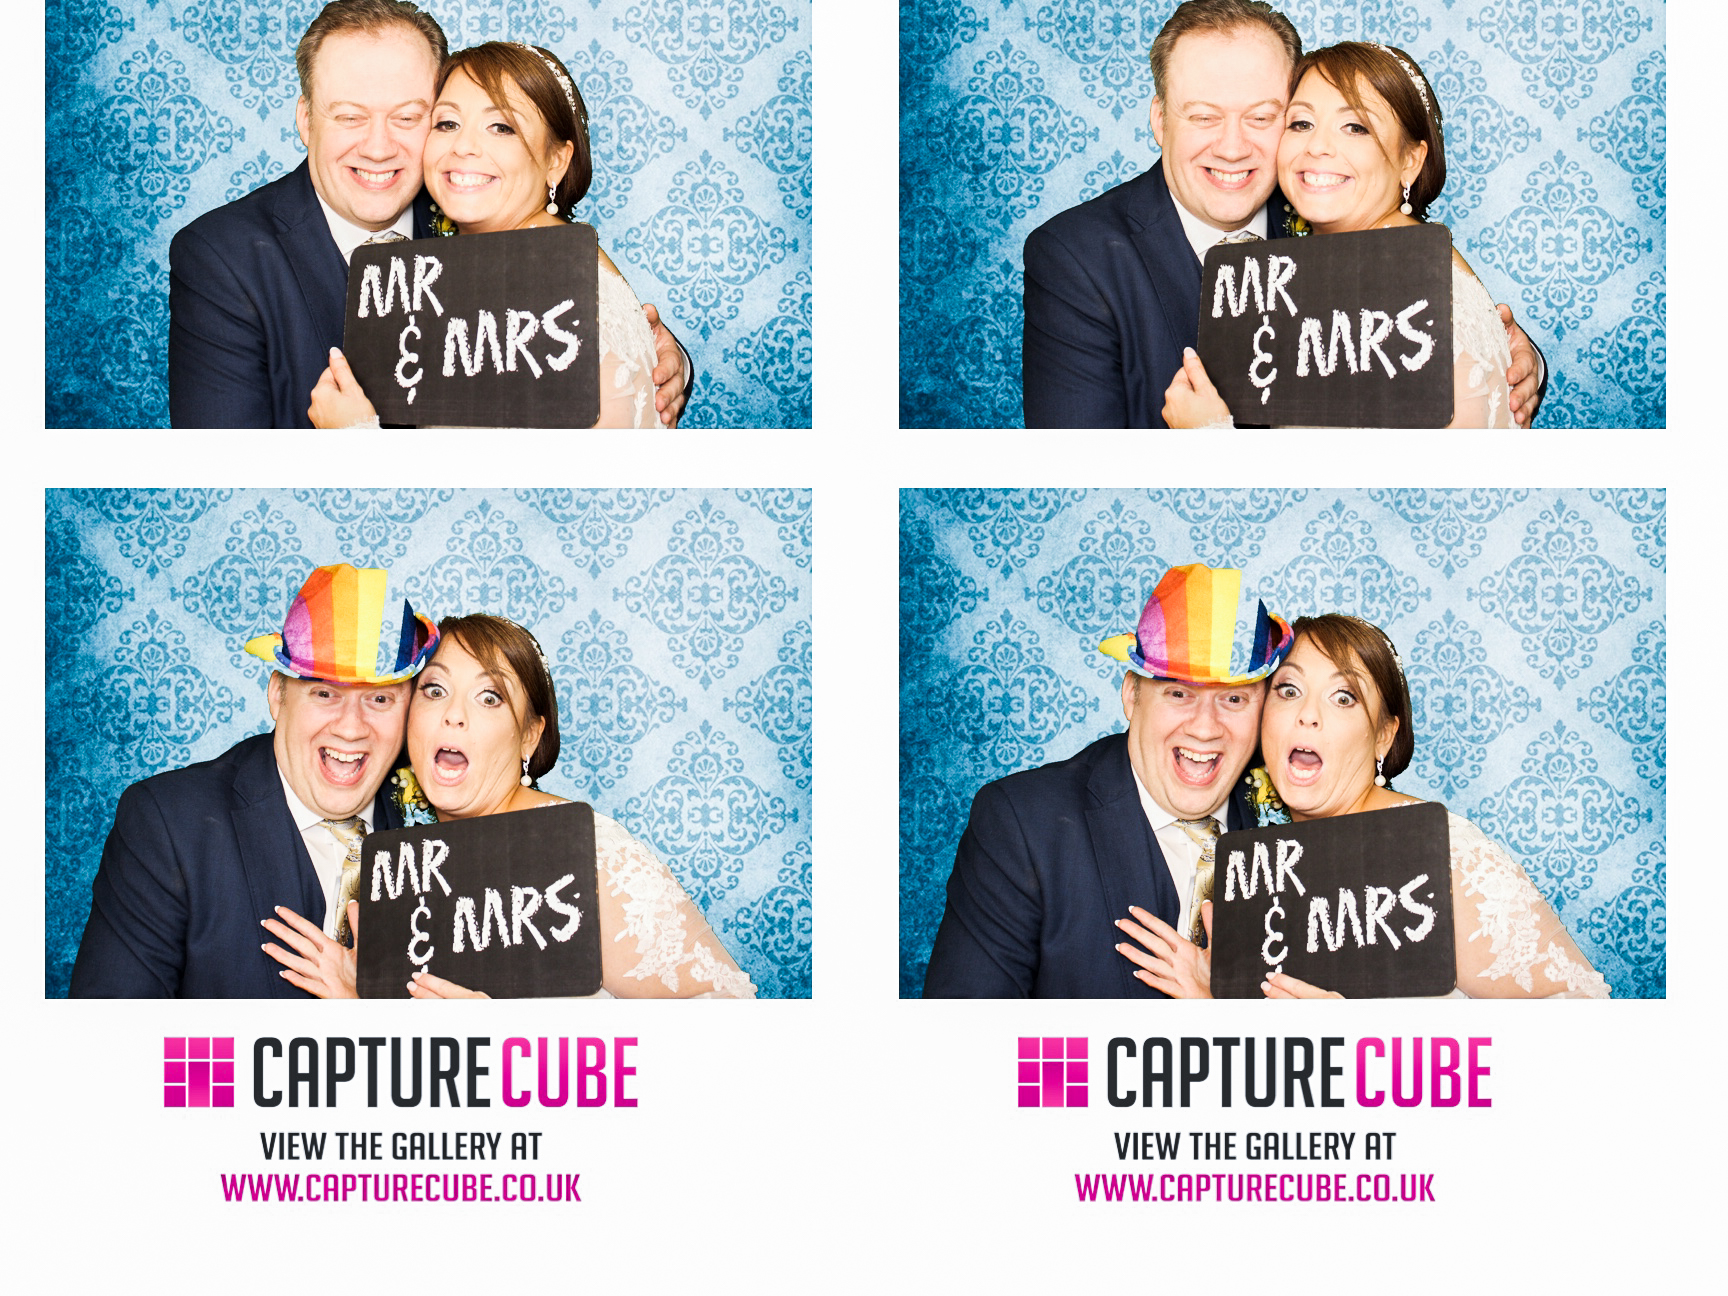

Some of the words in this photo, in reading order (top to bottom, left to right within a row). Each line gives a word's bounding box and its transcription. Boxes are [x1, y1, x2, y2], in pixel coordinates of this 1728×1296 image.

[357, 254, 444, 318] MR
[1211, 254, 1298, 318] MR
[370, 838, 452, 902] MR
[1224, 838, 1306, 902] MR
